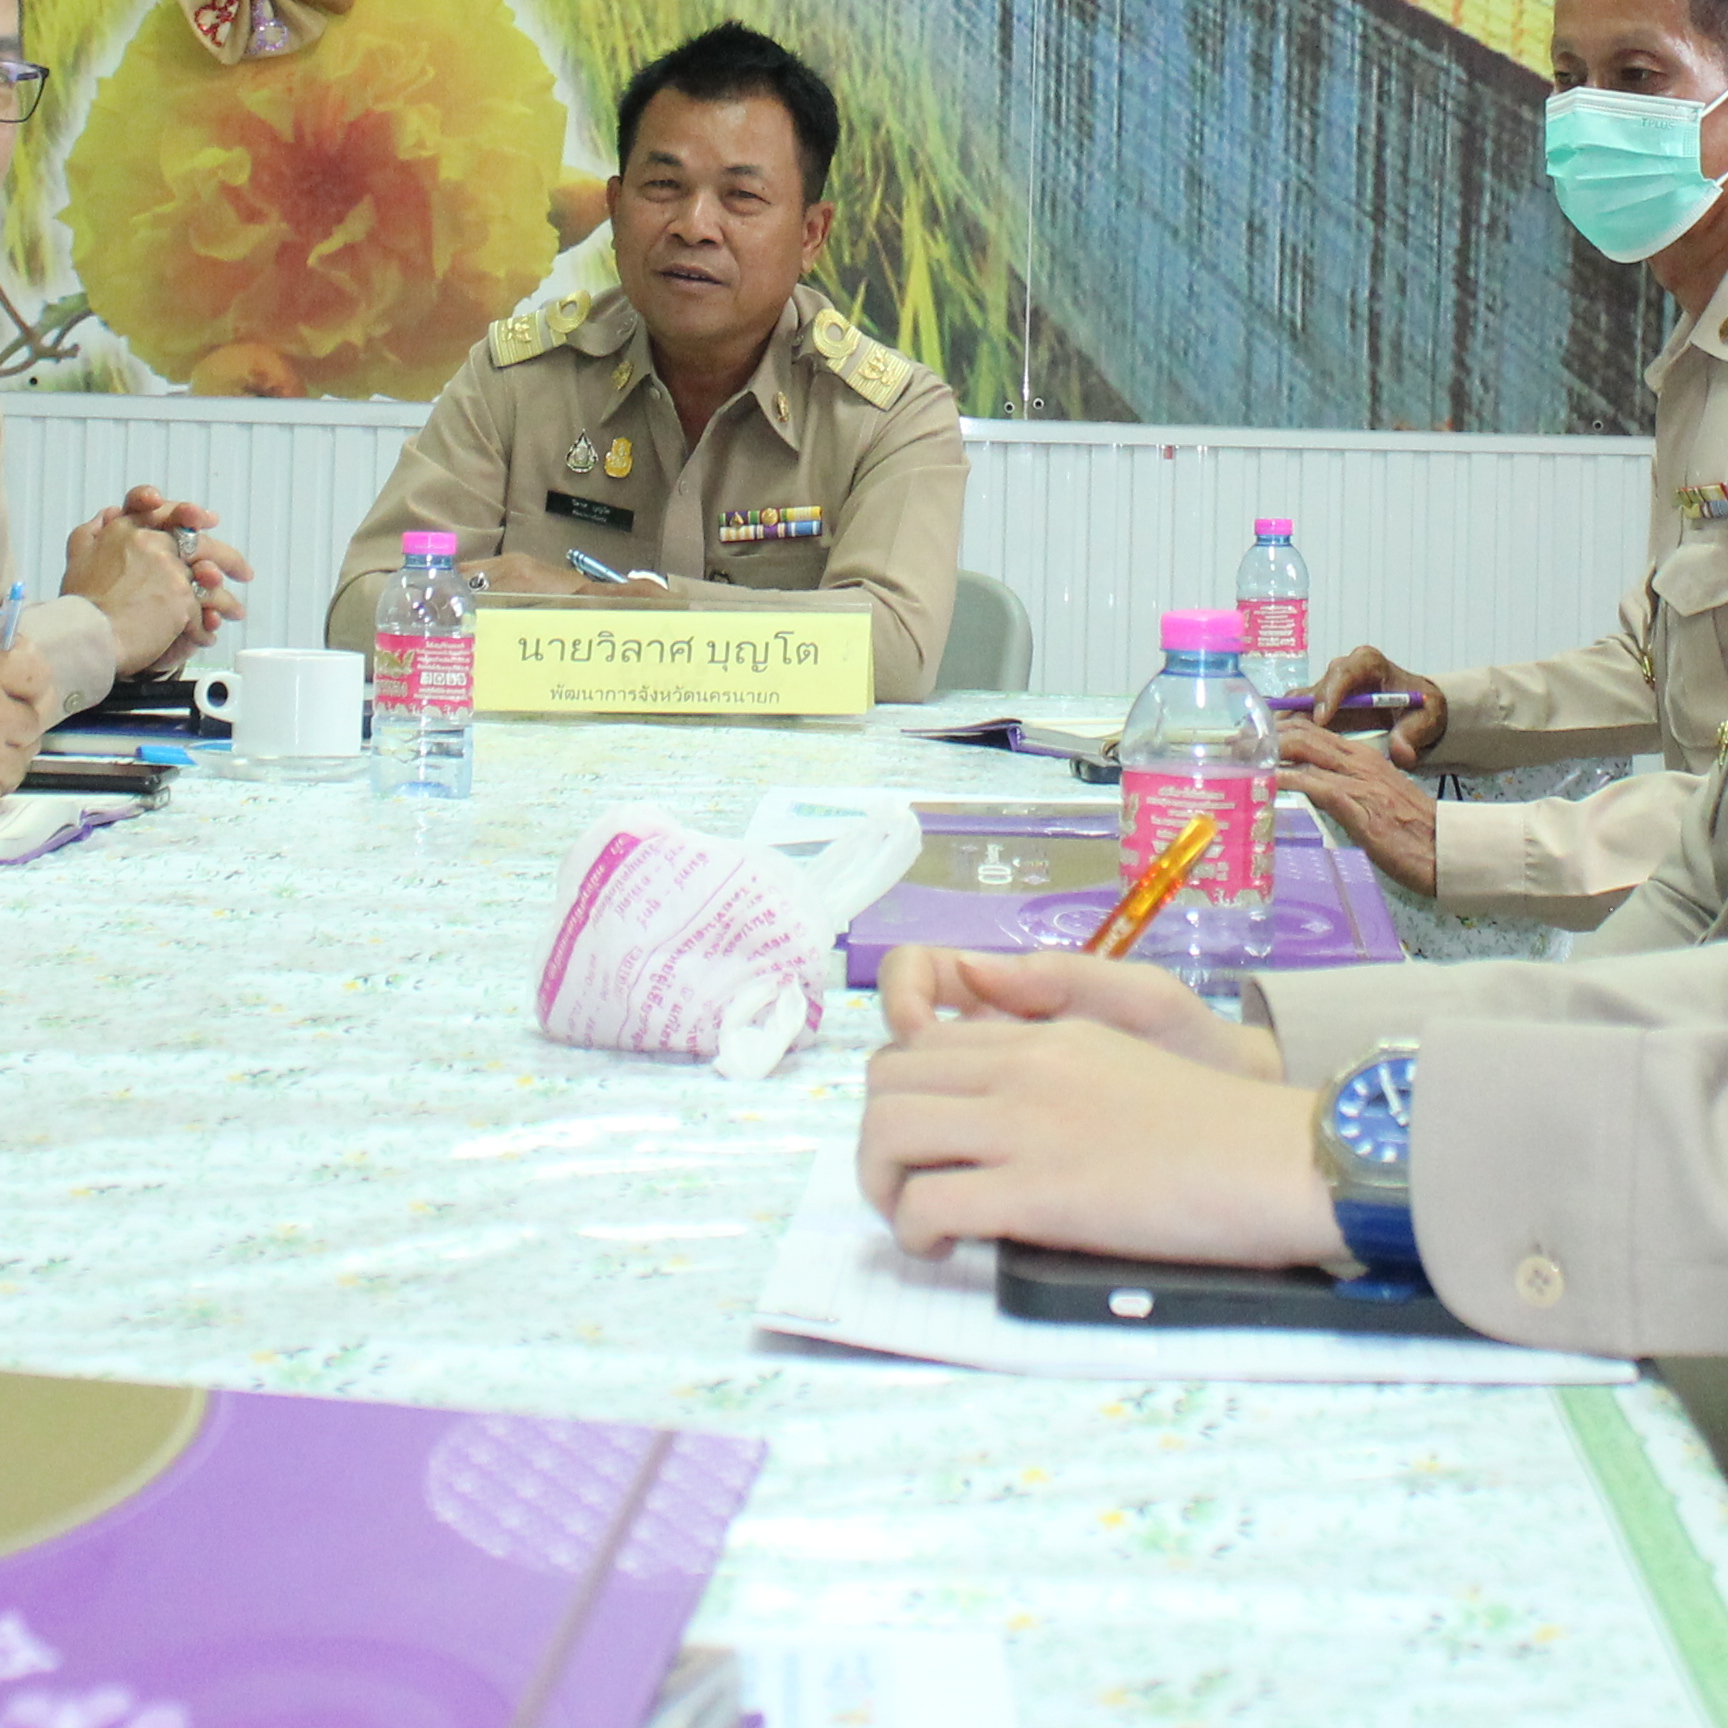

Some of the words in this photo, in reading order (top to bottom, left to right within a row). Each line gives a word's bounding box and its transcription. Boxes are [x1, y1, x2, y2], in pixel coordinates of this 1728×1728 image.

[518, 630, 693, 666] นายวิลาศ
[706, 630, 820, 673] บุญโต
[549, 682, 780, 705] พัฒนาการจังหวัดนครนายก
